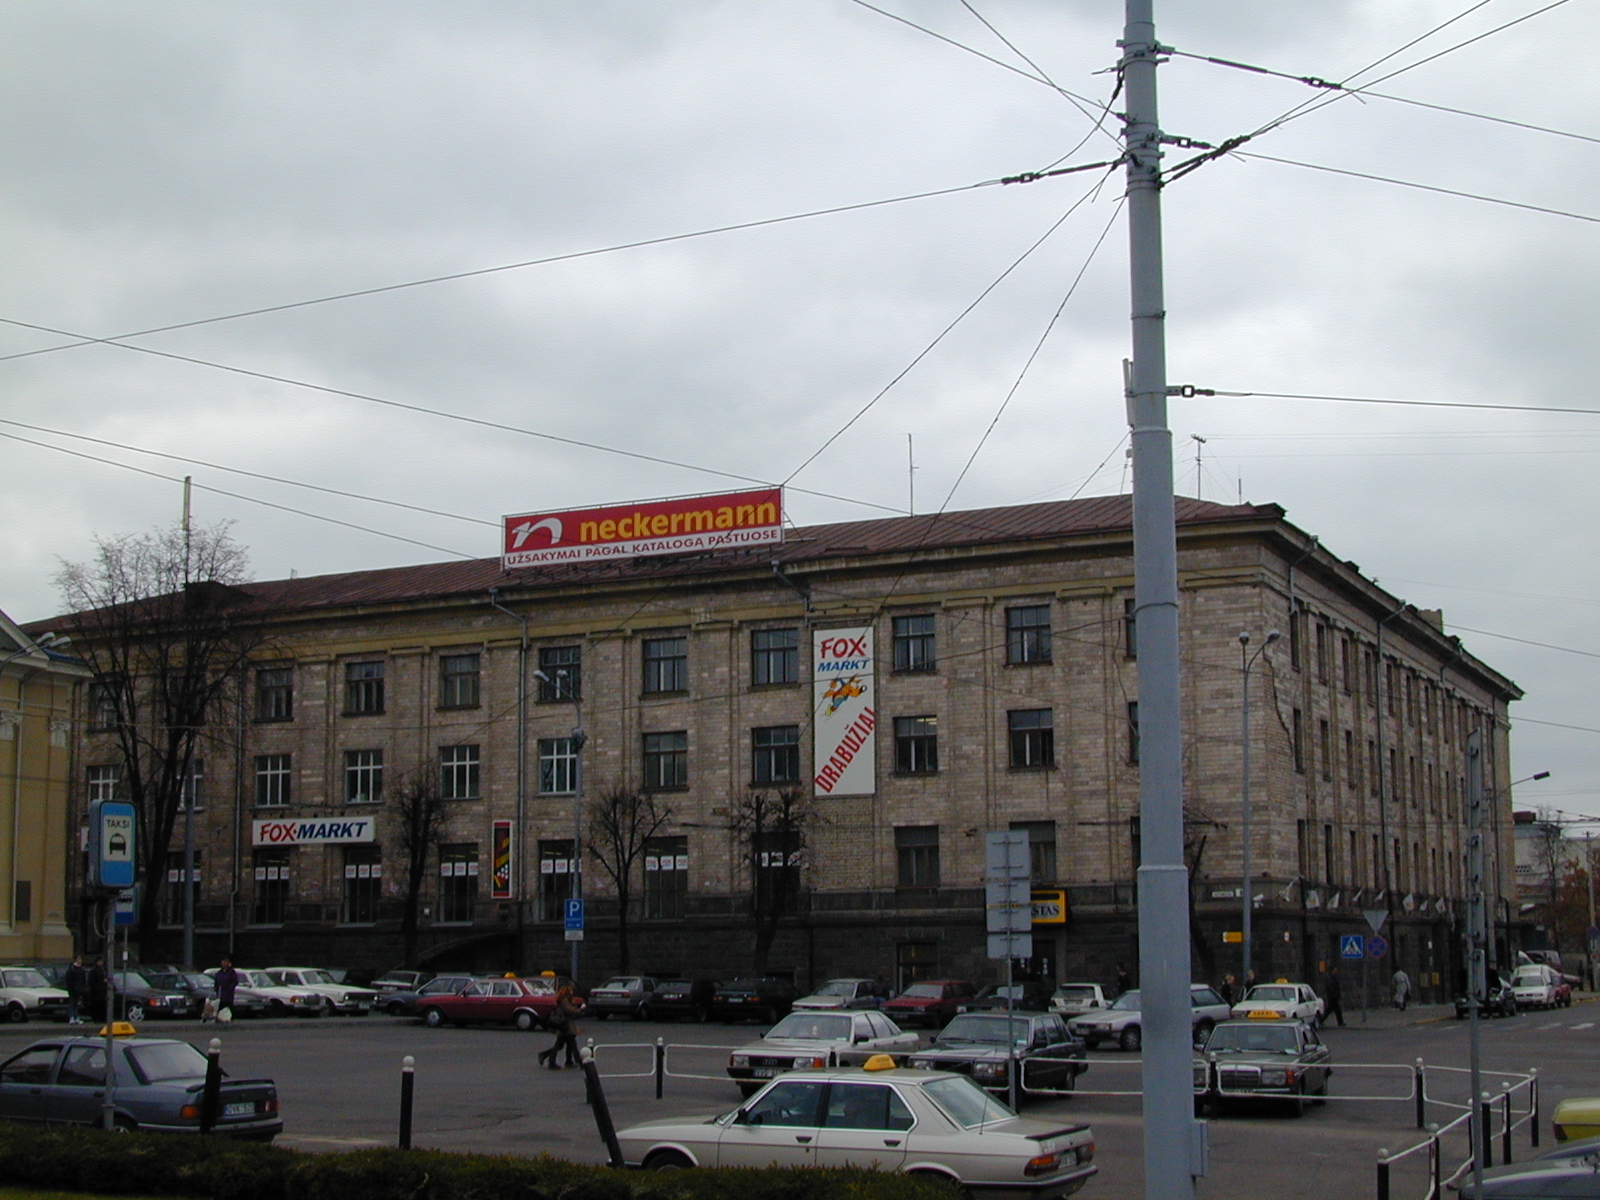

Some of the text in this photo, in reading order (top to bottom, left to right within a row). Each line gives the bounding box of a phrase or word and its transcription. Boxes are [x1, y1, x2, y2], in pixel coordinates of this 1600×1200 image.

[579, 501, 776, 542] neckermann
[507, 549, 581, 566] UŽSAKYMAI
[586, 545, 628, 558] PAGAL
[817, 659, 871, 673] MARKT
[106, 819, 130, 829] TAKSI
[569, 901, 580, 917] P
